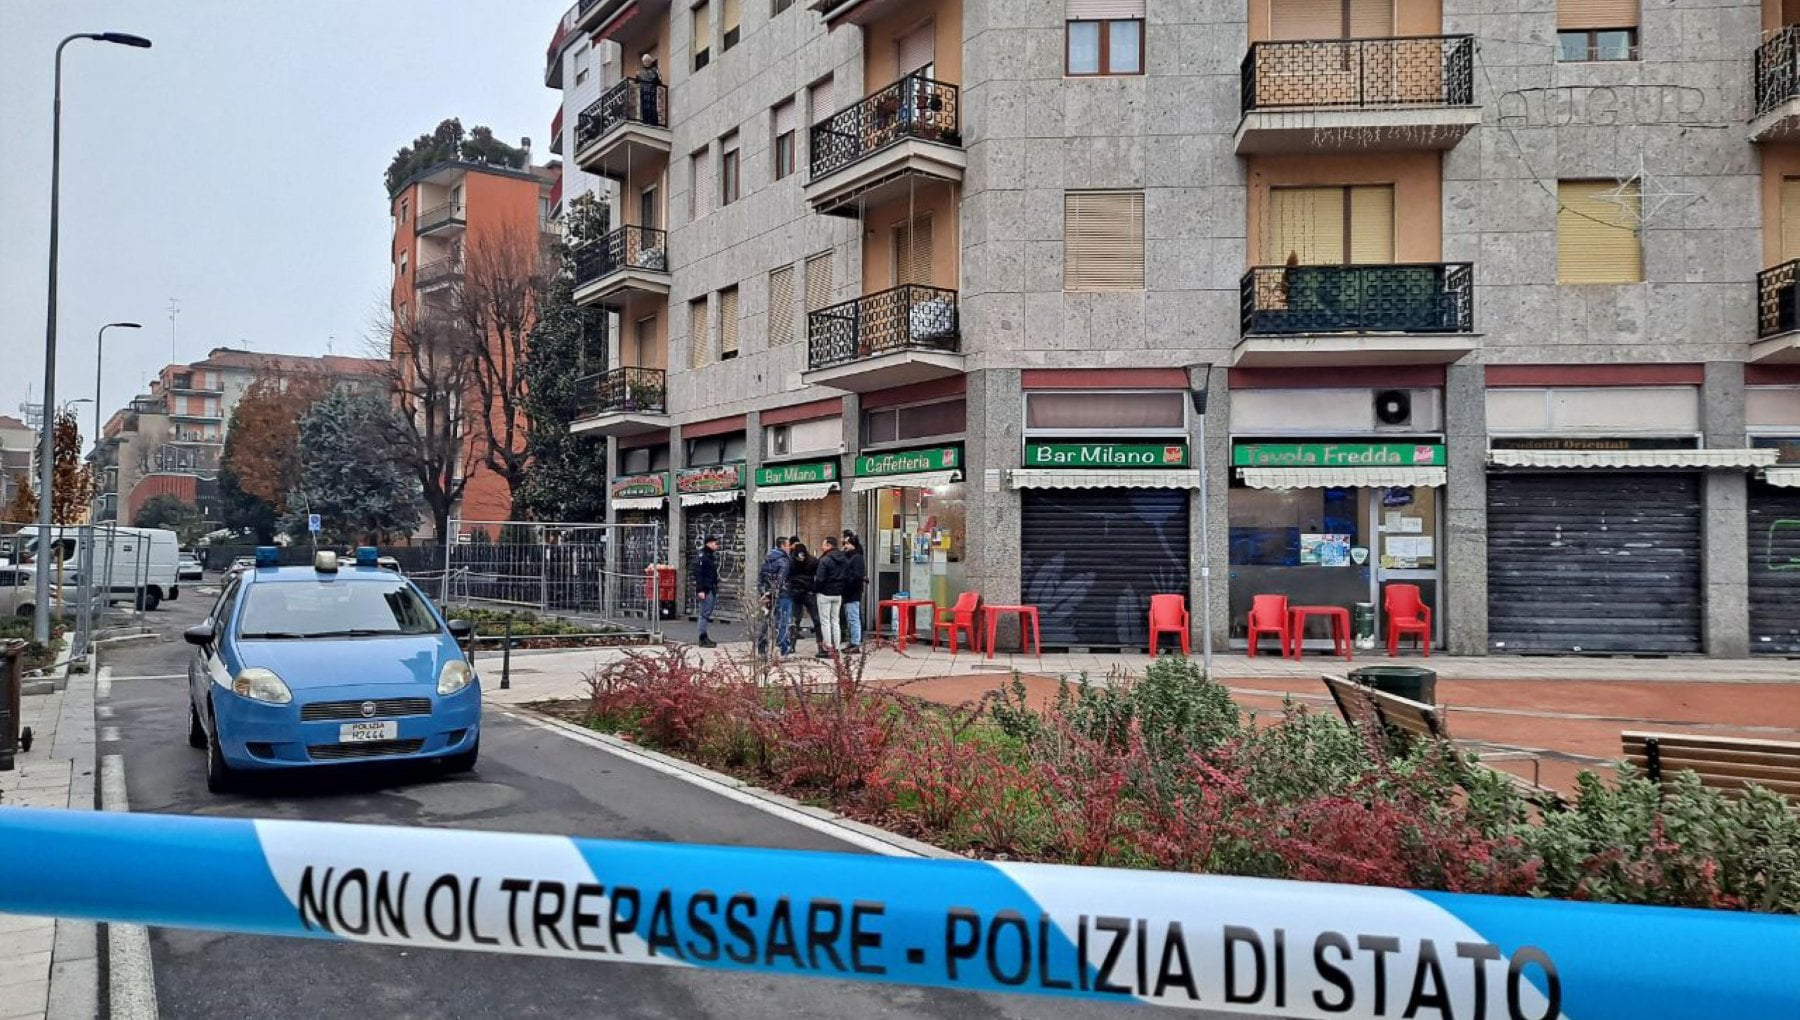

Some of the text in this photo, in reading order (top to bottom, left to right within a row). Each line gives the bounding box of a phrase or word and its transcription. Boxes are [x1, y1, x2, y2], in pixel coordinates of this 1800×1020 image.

[1036, 446, 1077, 463] Bar
[1080, 446, 1155, 463] Milano
[1245, 446, 1316, 465] Tavola
[1323, 446, 1401, 464] Fredda
[865, 455, 930, 474] Caffetteria
[765, 470, 782, 483] Bar
[784, 468, 817, 481] Milano
[352, 722, 385, 731] POLIZIA
[299, 865, 411, 939] NON
[424, 872, 888, 975] OLTREPASSARE
[946, 907, 1201, 1001] POLIZIA
[1223, 924, 1286, 1009] DI
[1312, 931, 1562, 1020] STATO
